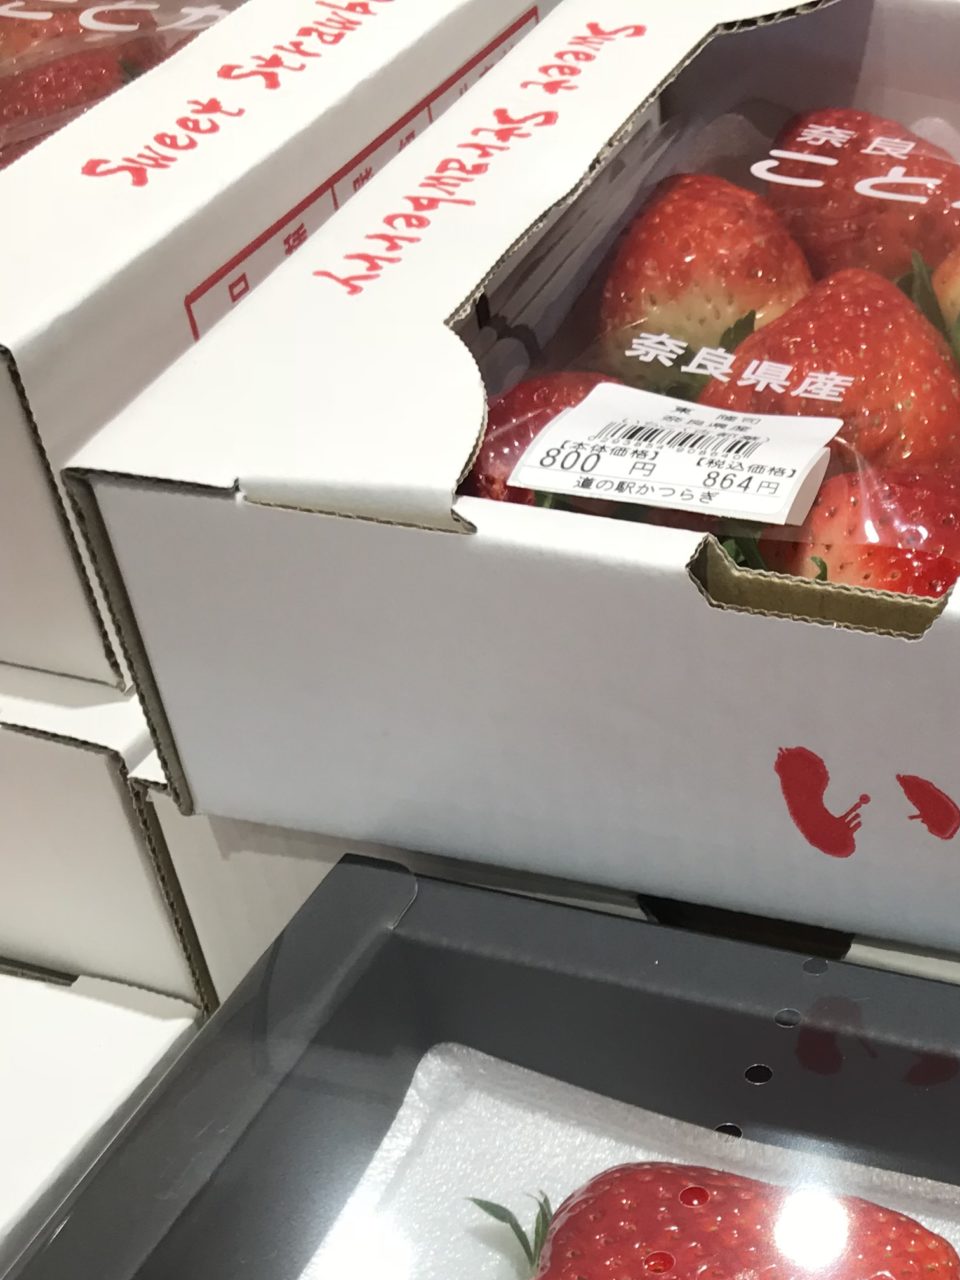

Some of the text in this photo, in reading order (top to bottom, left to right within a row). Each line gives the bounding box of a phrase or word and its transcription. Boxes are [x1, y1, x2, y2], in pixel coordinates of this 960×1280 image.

[520, 22, 647, 94] Sweet
[81, 98, 246, 187] Sweet
[217, 0, 394, 89] Strawb
[796, 124, 917, 160] 奈良
[312, 108, 559, 296] Strawberry
[624, 332, 856, 403] 奈良県産
[539, 447, 602, 474] 800
[628, 460, 657, 478] 円
[695, 456, 798, 479] 【税込価格】
[573, 475, 720, 504] 道の駅かつらぎ
